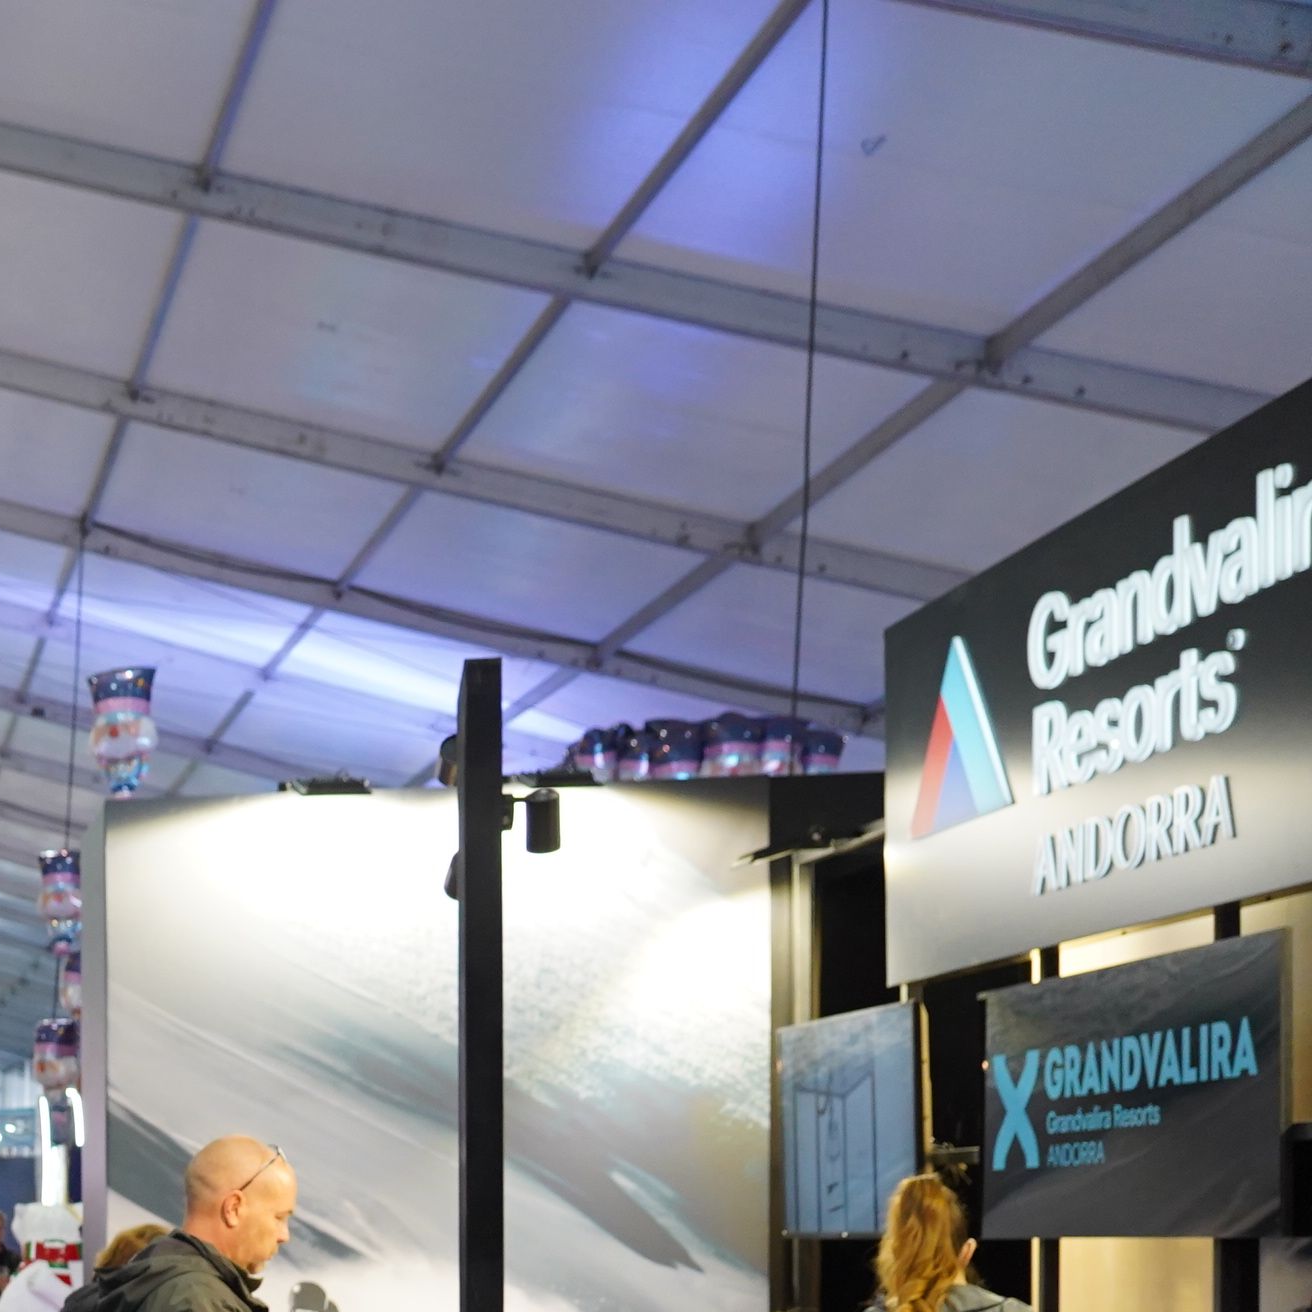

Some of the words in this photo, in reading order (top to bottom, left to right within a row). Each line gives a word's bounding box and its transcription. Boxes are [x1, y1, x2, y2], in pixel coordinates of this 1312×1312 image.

[1032, 774, 1238, 896] ANDORRA
[1043, 1016, 1259, 1101] GRANDVALIRA
[1046, 1104, 1112, 1135] Grandvalira
[1113, 1103, 1161, 1128] Resorts
[1047, 1140, 1106, 1168] ANDORRA
